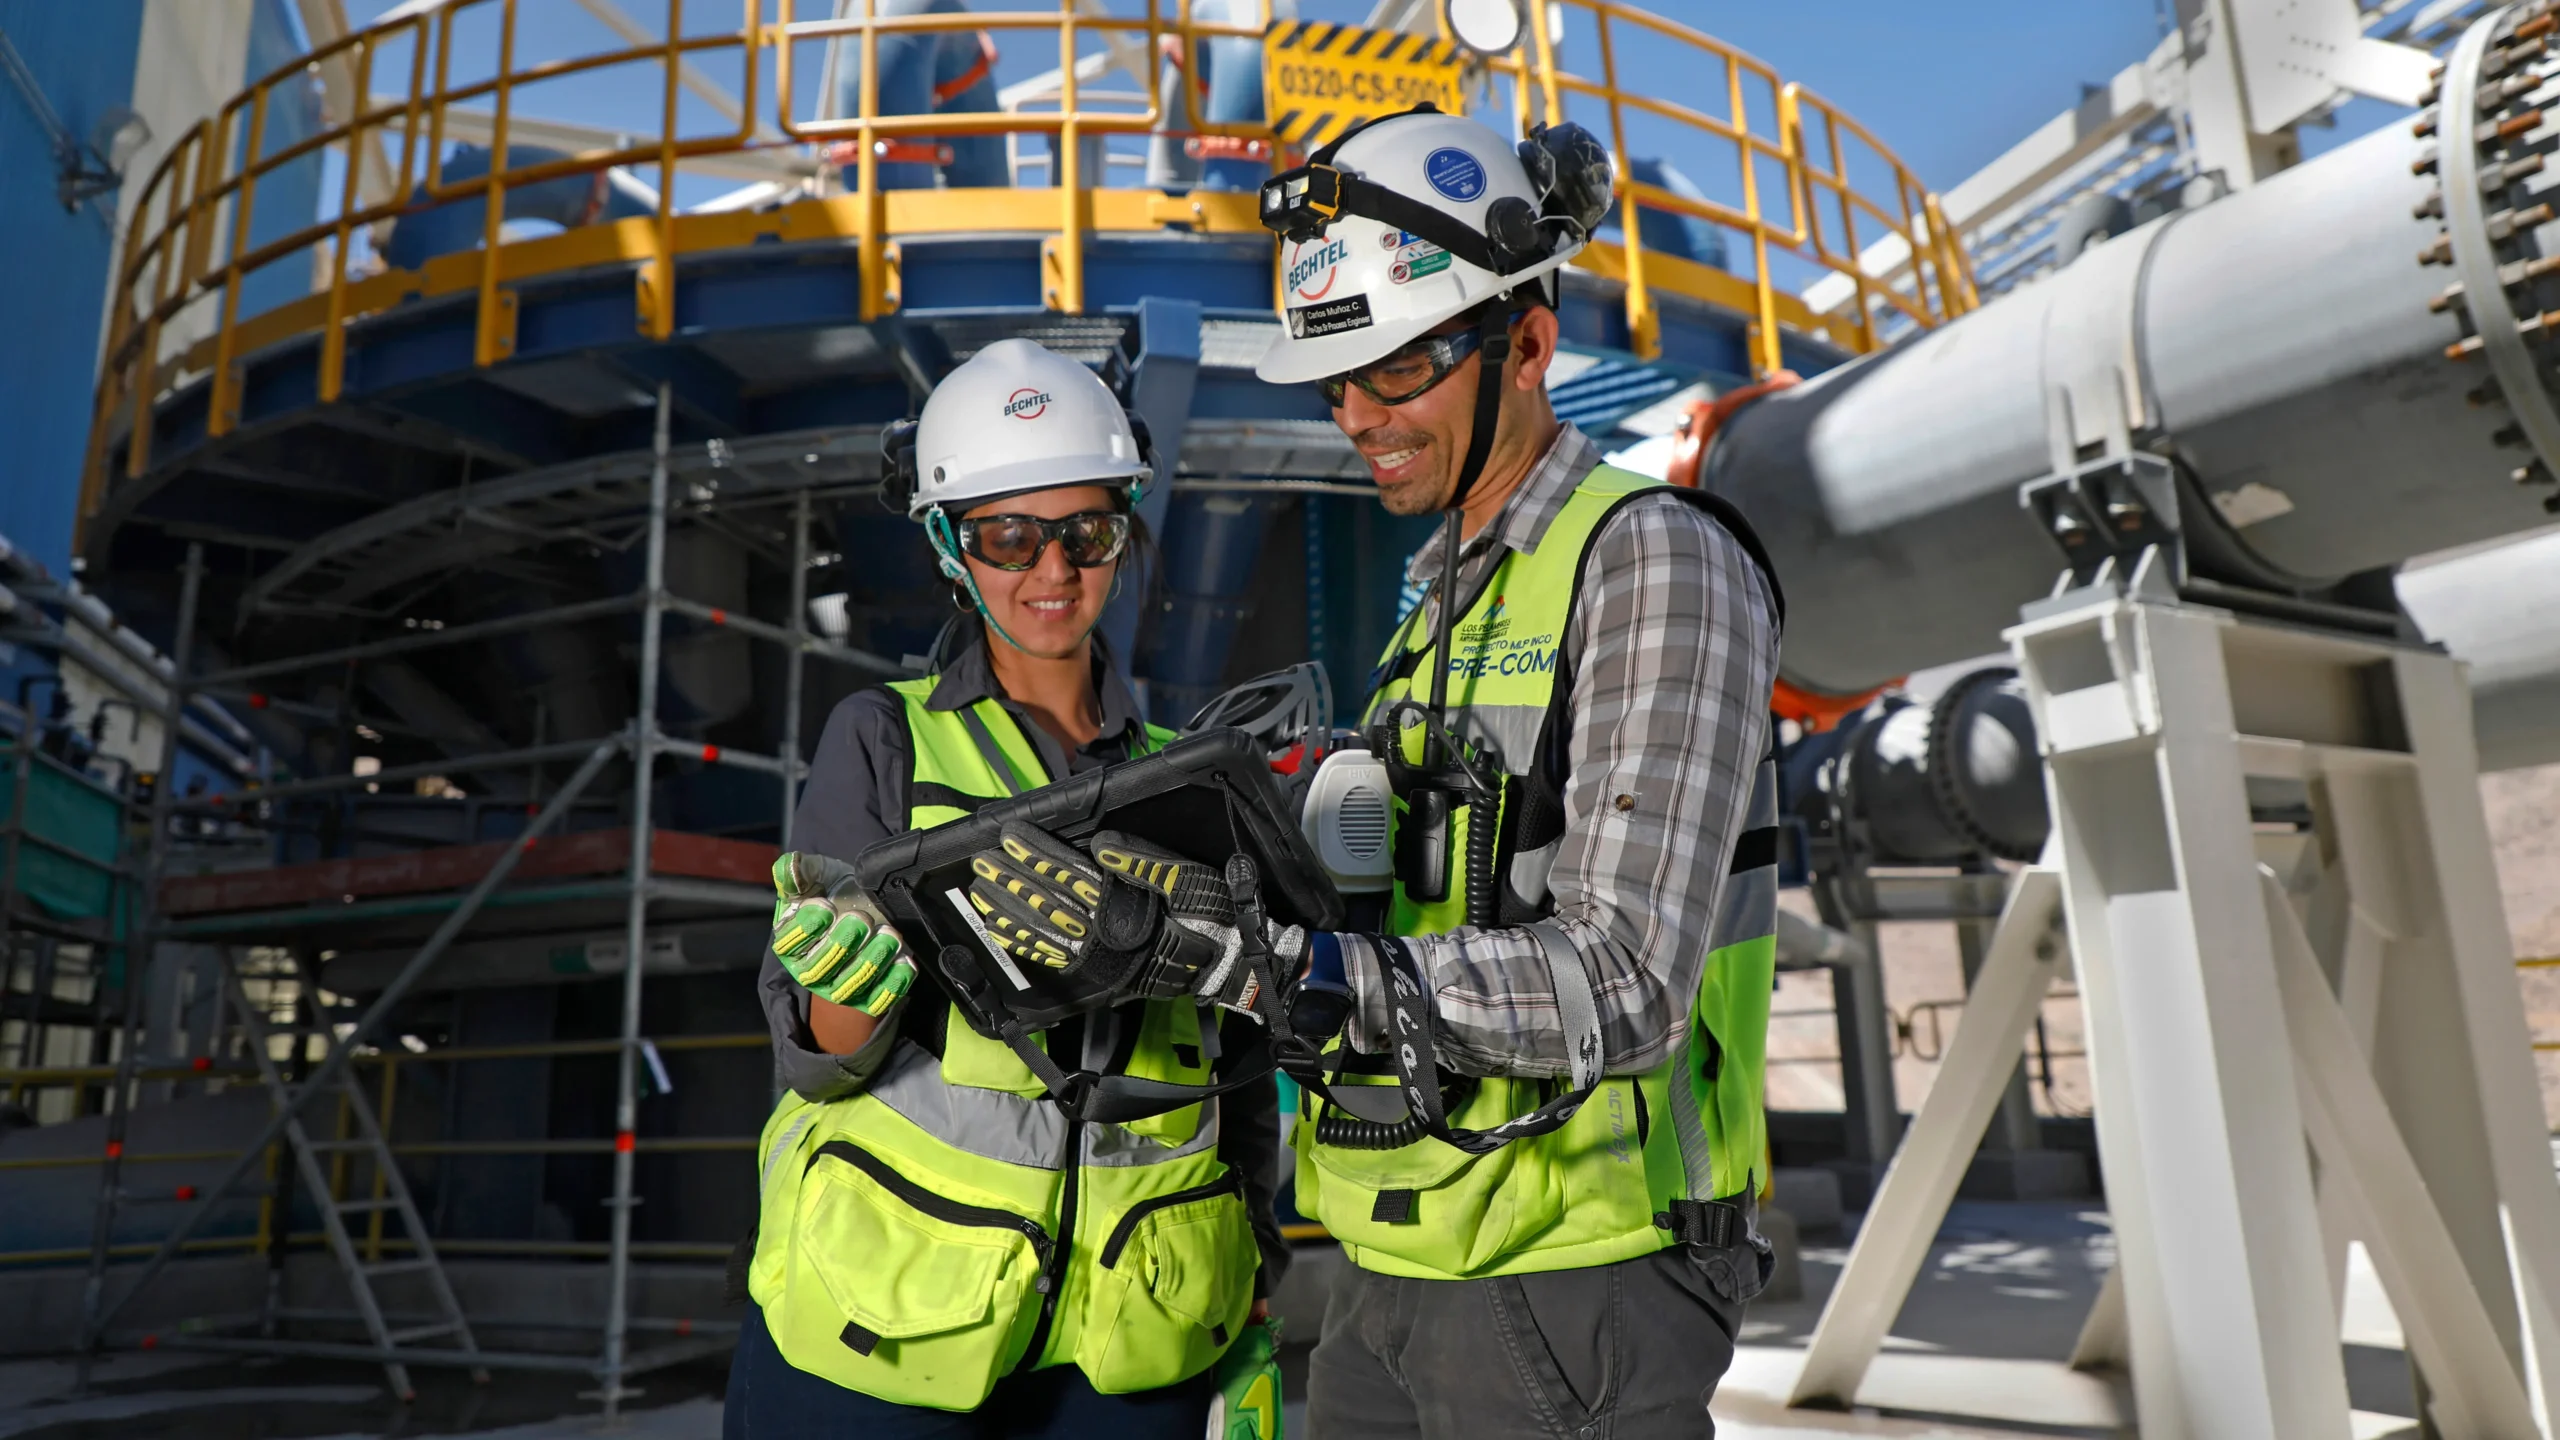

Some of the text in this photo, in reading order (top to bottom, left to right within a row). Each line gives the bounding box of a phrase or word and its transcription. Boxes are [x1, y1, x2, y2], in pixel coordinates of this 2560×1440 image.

[1280, 64, 1451, 110] 0320-CS-5001
[1289, 239, 1348, 293] BECHTEL
[1307, 301, 1362, 320] Carlos Muñoz C.
[1327, 319, 1348, 331] Process
[1347, 315, 1371, 328] Engineer
[1004, 393, 1053, 416] BECHTEL
[1462, 624, 1478, 632] LOS
[1462, 633, 1553, 655] PROYECTO MLP INCO
[1447, 648, 1558, 680] PRE-COM
[965, 912, 1011, 968] FRANCISCO MURO
